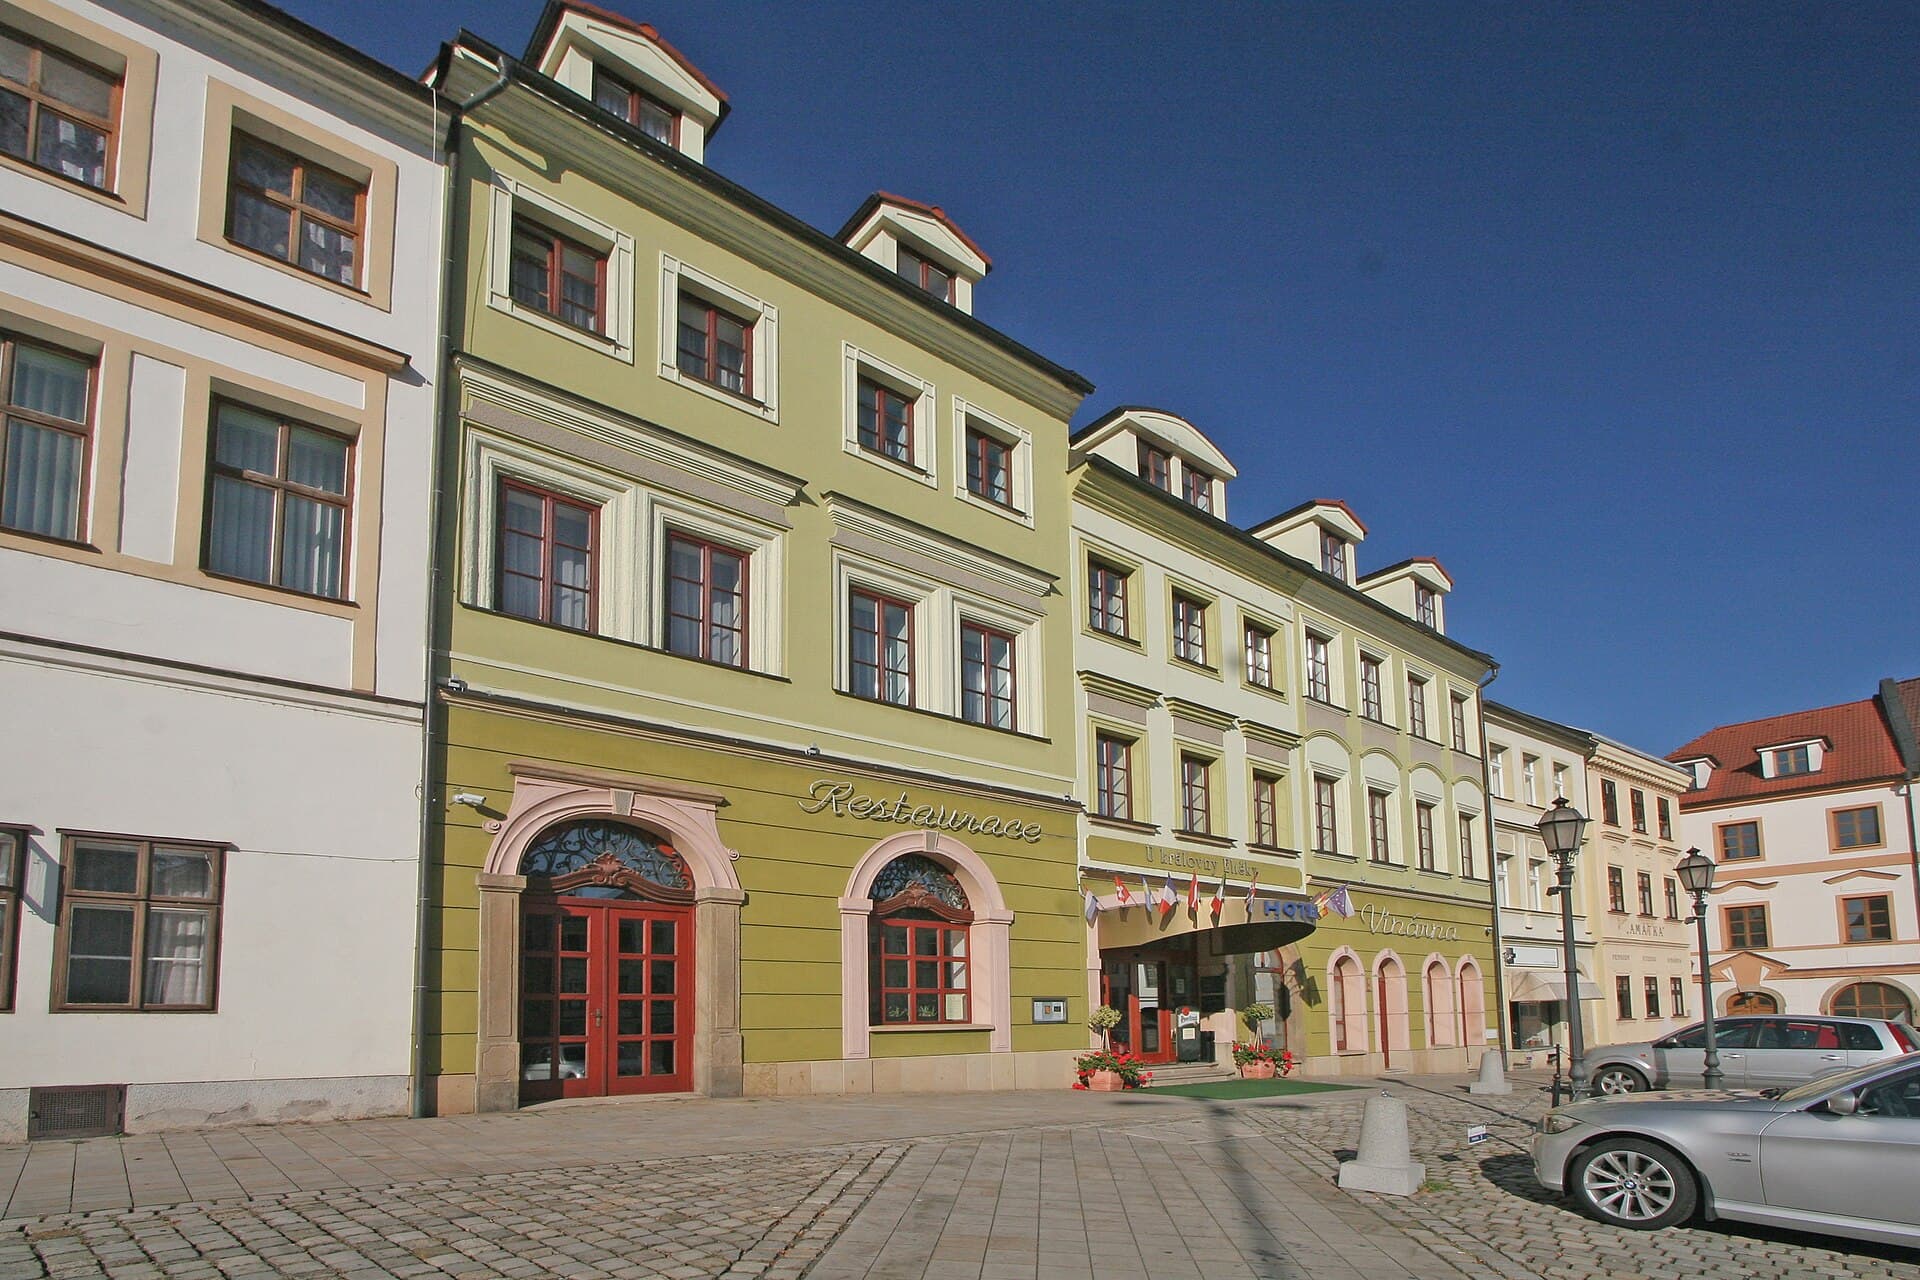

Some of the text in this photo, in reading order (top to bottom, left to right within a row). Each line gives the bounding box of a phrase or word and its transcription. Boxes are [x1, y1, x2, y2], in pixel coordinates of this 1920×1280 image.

[798, 779, 1041, 843] Restaurace
[1145, 845, 1153, 862] U
[1360, 902, 1460, 942] Vinárna
